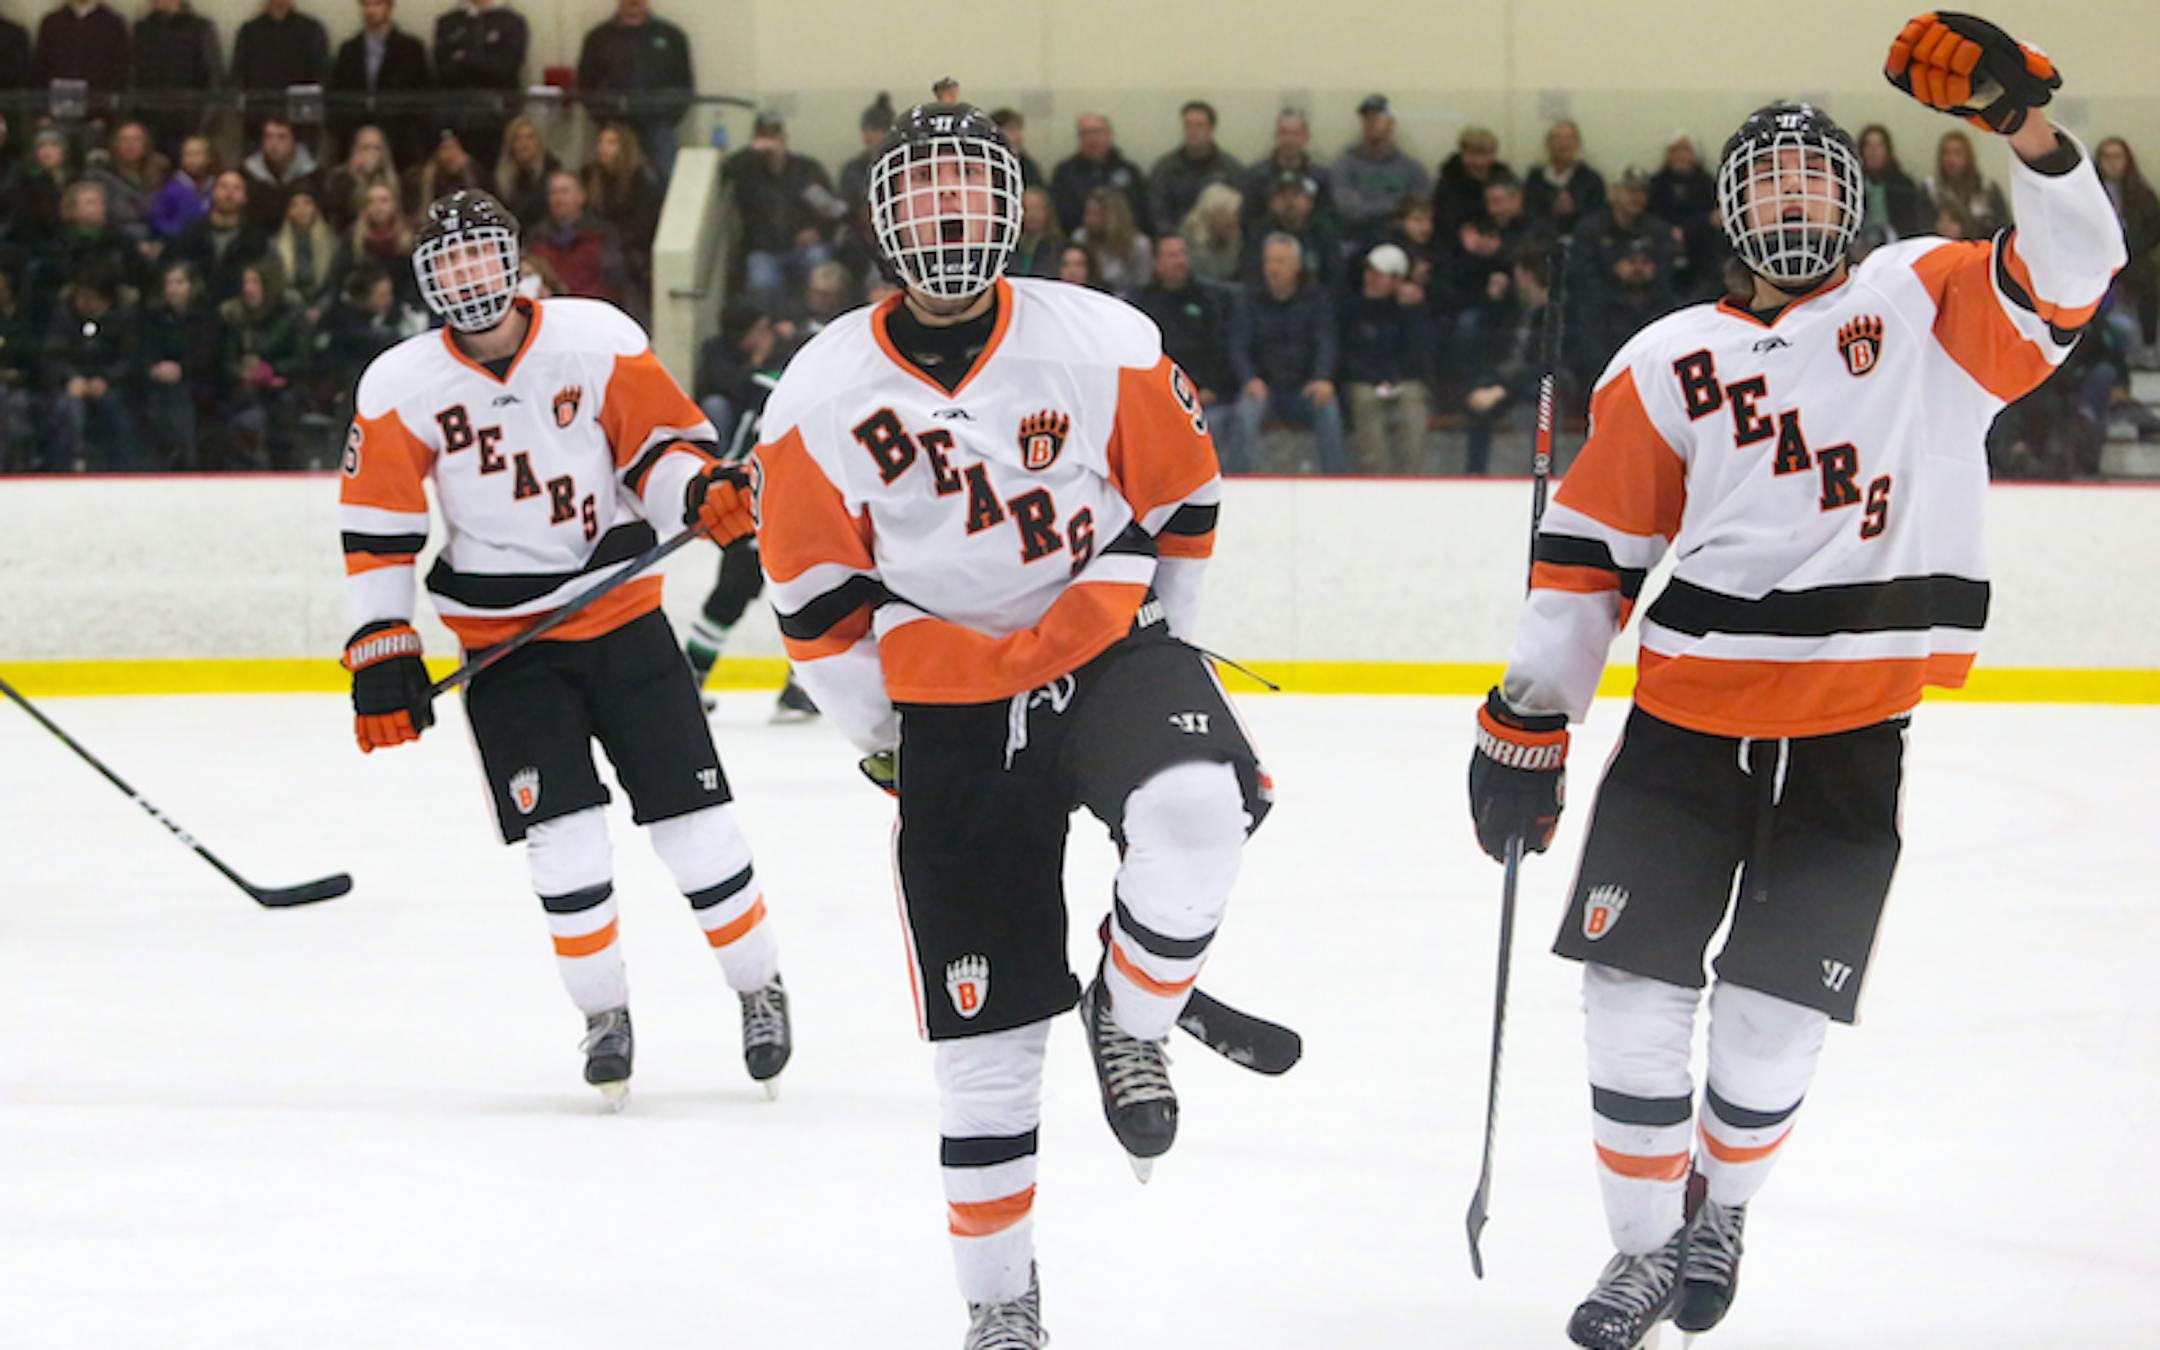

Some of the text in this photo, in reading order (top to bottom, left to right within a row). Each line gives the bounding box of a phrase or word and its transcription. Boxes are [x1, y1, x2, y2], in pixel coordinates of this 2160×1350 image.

[435, 404, 598, 542] BEARS
[851, 407, 1094, 578] BEARS
[1672, 348, 1891, 540] BEARS
[959, 983, 977, 1009] B
